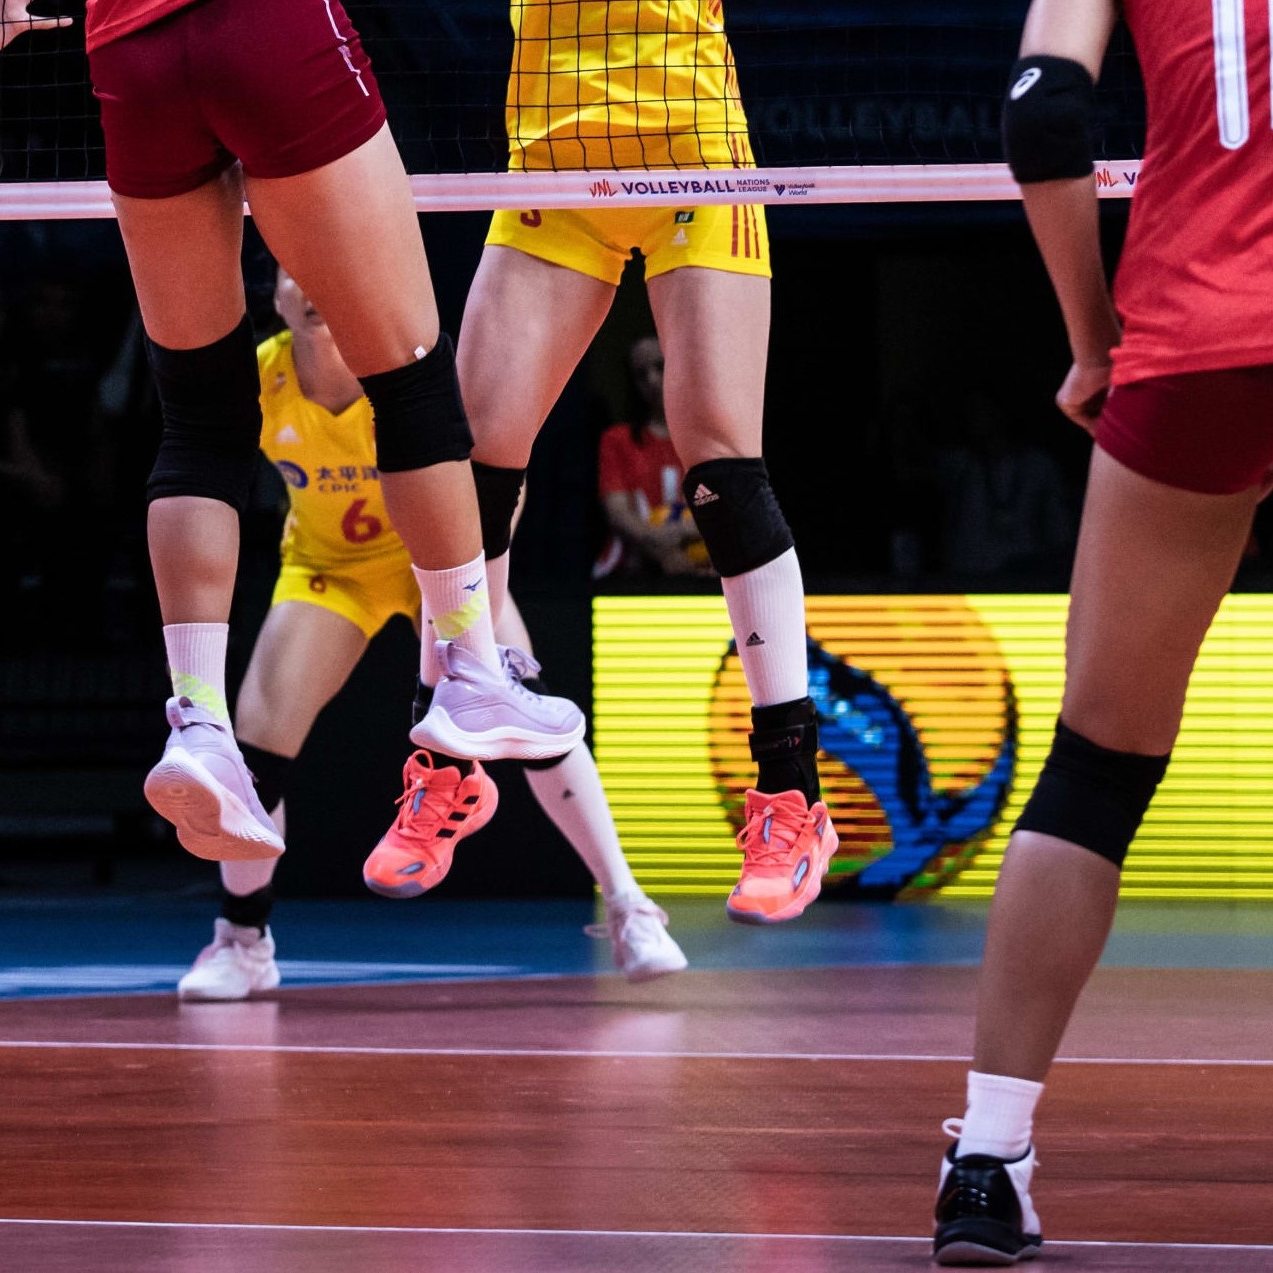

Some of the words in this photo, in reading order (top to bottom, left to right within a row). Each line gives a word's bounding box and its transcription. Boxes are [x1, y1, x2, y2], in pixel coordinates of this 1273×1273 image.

[1094, 168, 1119, 187] NL
[622, 180, 735, 195] VOLLEYBALL
[341, 499, 382, 544] 6
